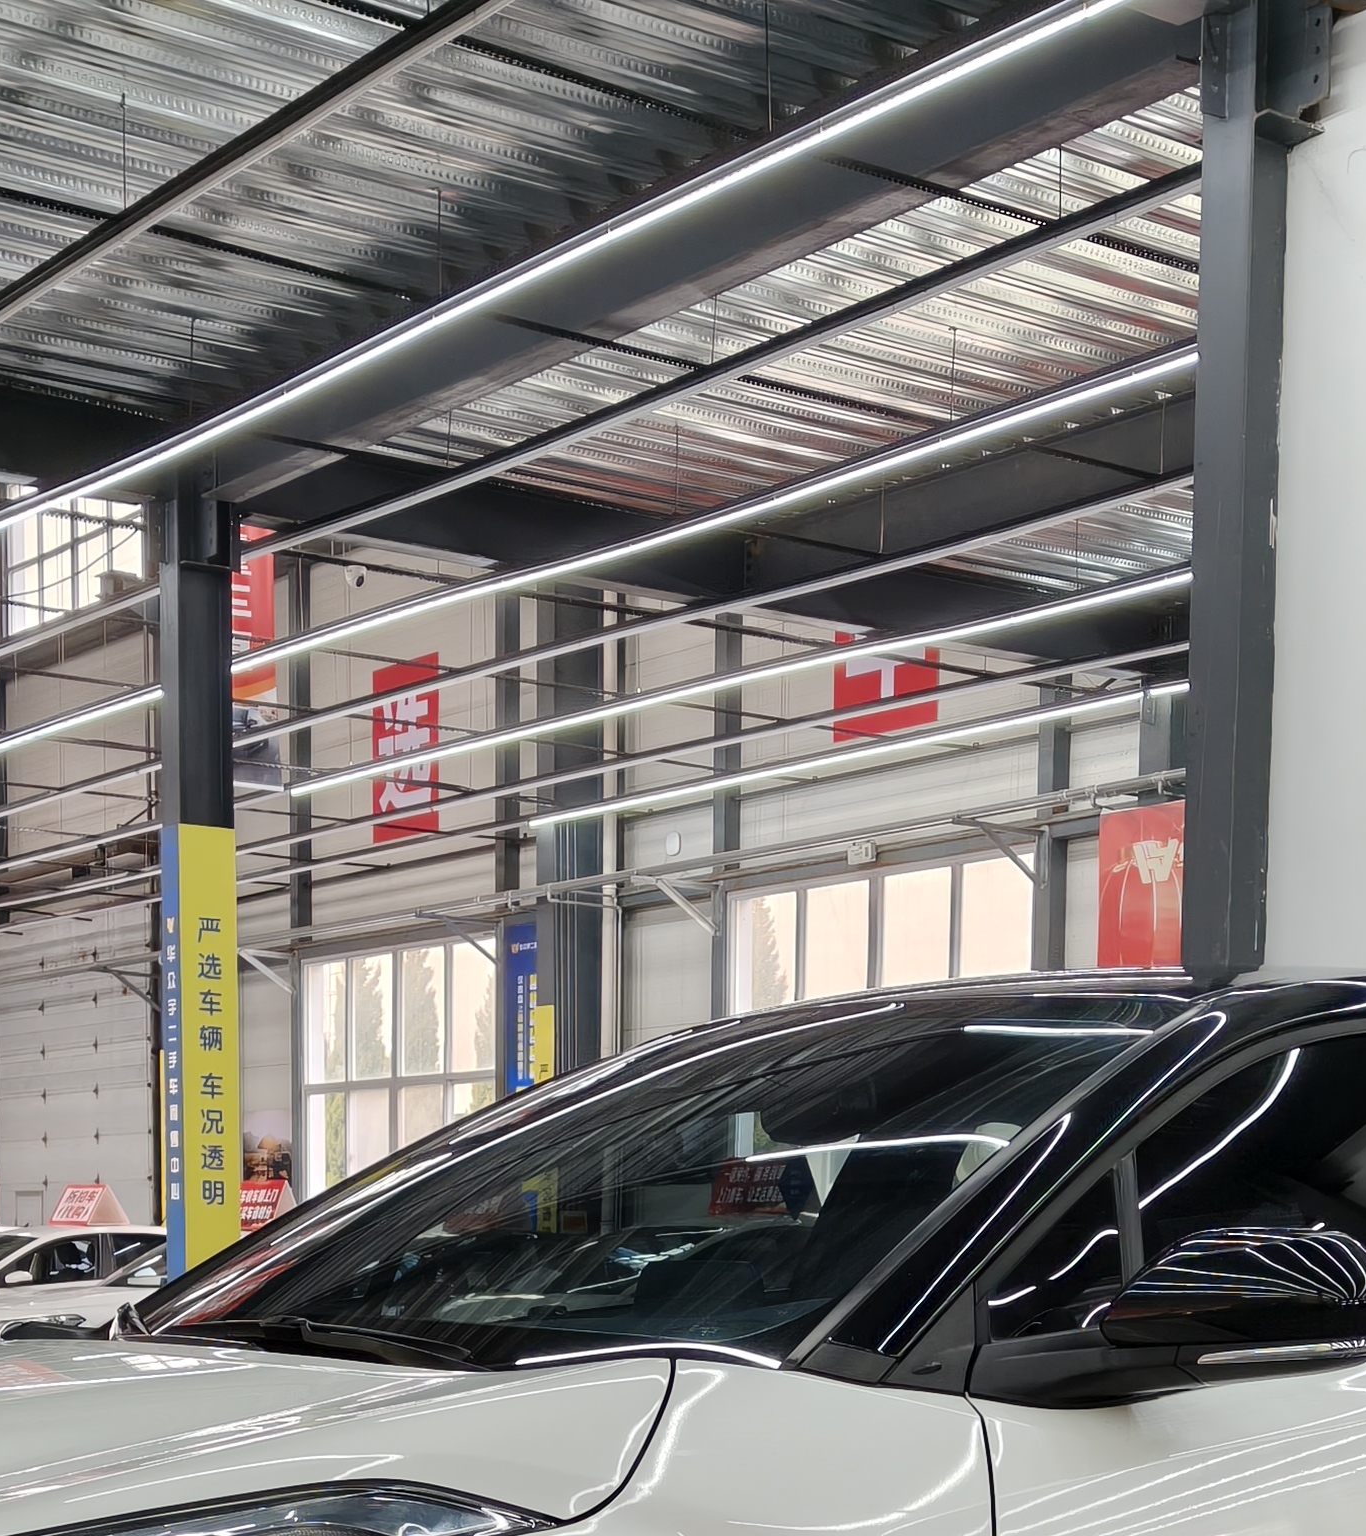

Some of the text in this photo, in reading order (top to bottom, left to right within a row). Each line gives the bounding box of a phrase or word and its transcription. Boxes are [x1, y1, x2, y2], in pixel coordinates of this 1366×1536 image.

[198, 917, 226, 1207] 严选车辆 车况透明
